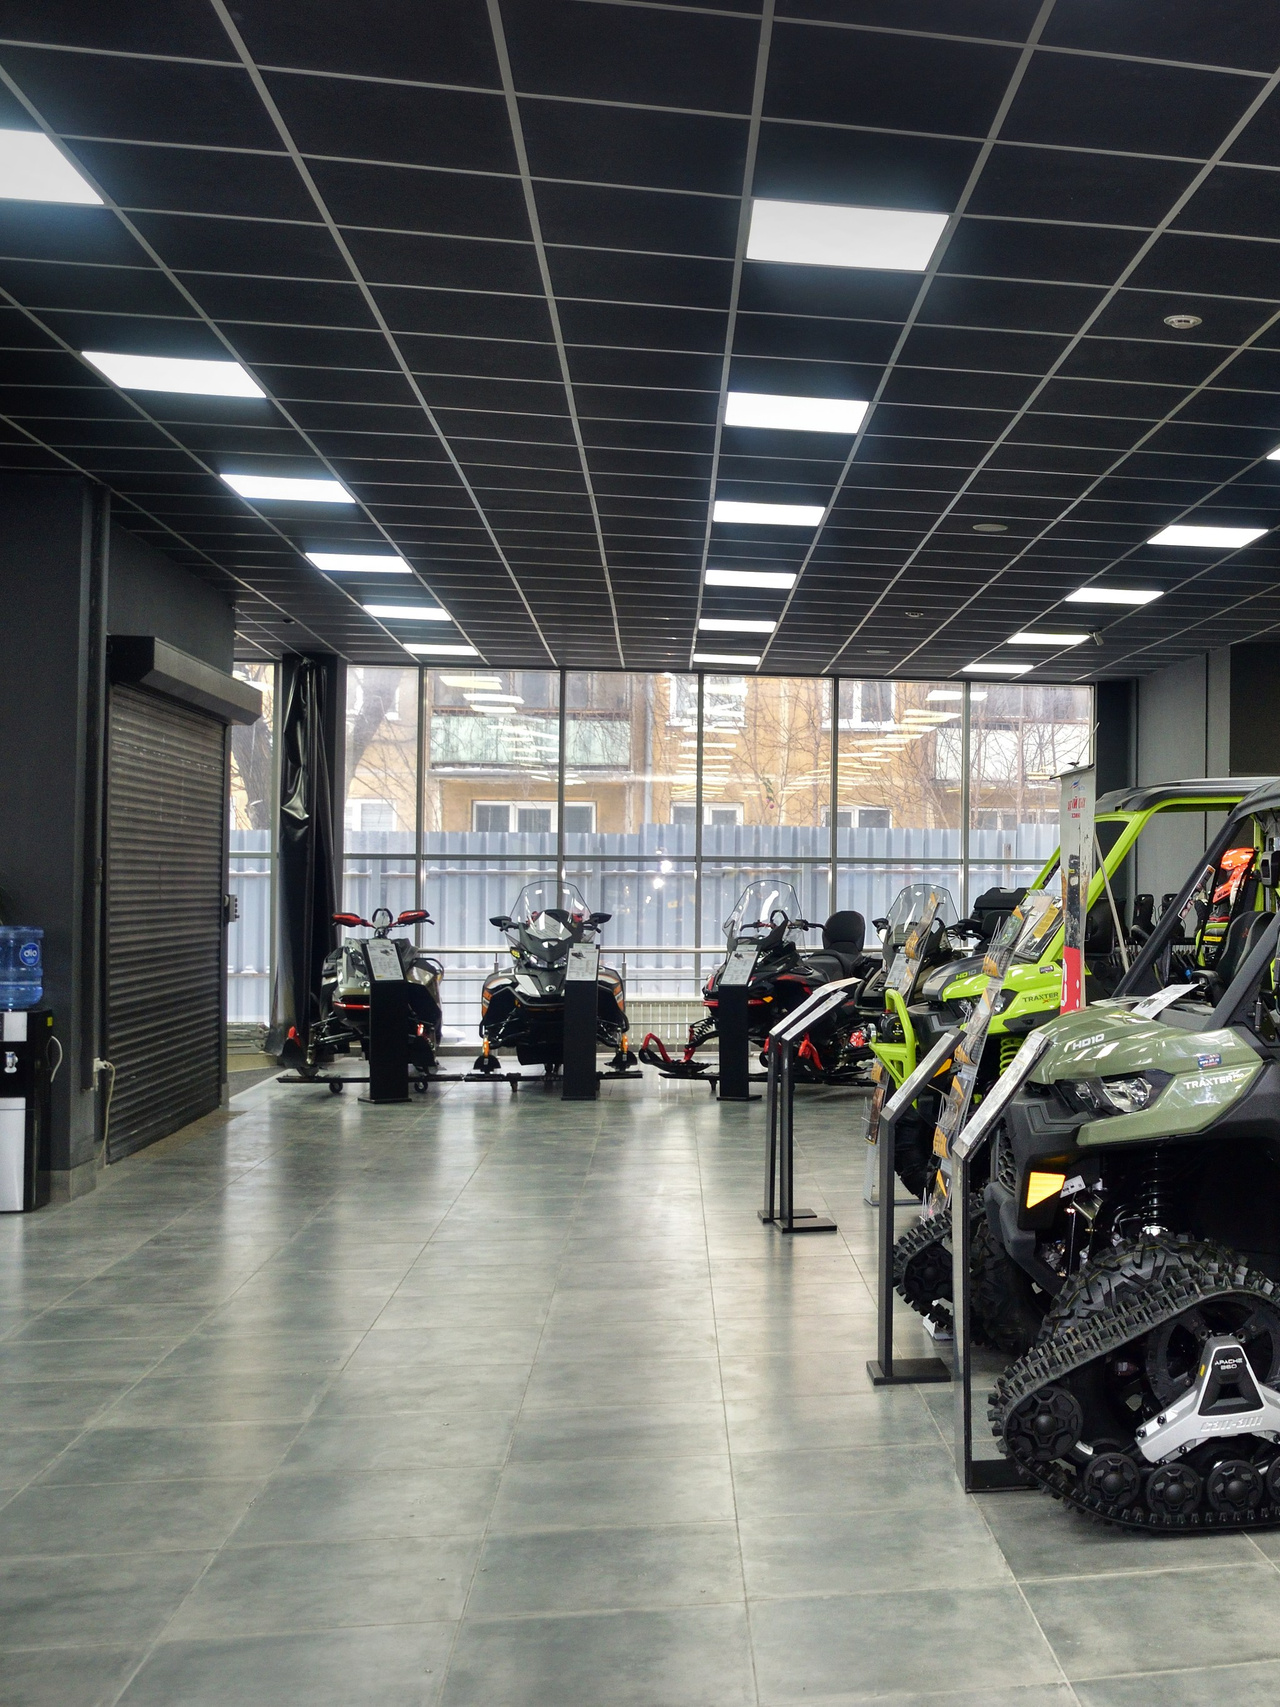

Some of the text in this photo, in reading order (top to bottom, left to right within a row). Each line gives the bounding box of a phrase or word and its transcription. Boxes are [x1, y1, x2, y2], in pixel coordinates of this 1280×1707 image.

[1022, 992, 1059, 1002] TRAXTER
[1072, 1033, 1105, 1050] HD10
[1183, 1075, 1233, 1089] TRAXTER
[1214, 1358, 1243, 1366] APACHE
